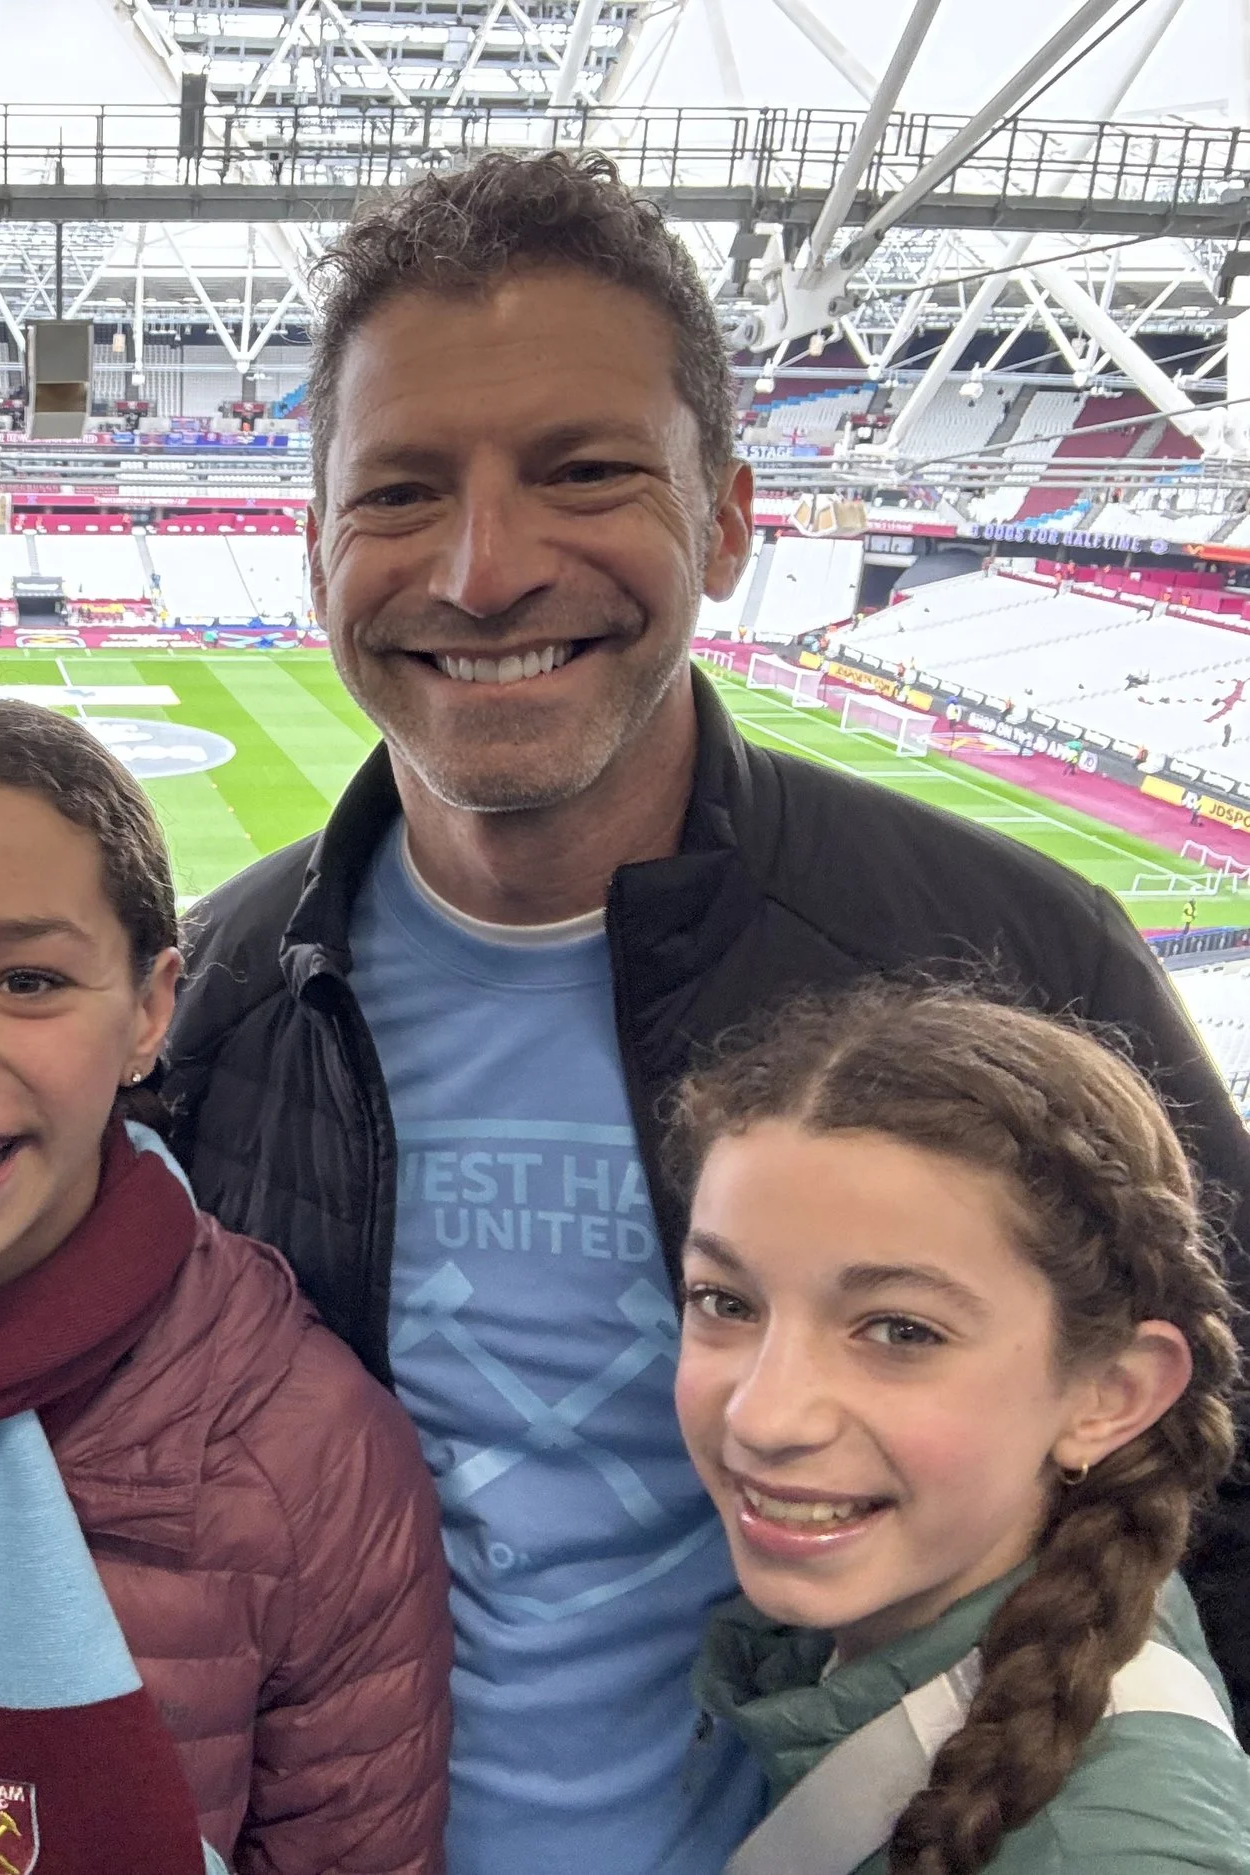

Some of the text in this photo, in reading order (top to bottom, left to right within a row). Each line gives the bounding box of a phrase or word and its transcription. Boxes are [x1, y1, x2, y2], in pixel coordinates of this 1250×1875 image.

[1028, 527, 1059, 545] FOR
[1062, 530, 1141, 553] HALFTIME
[435, 1207, 653, 1263] UNITED
